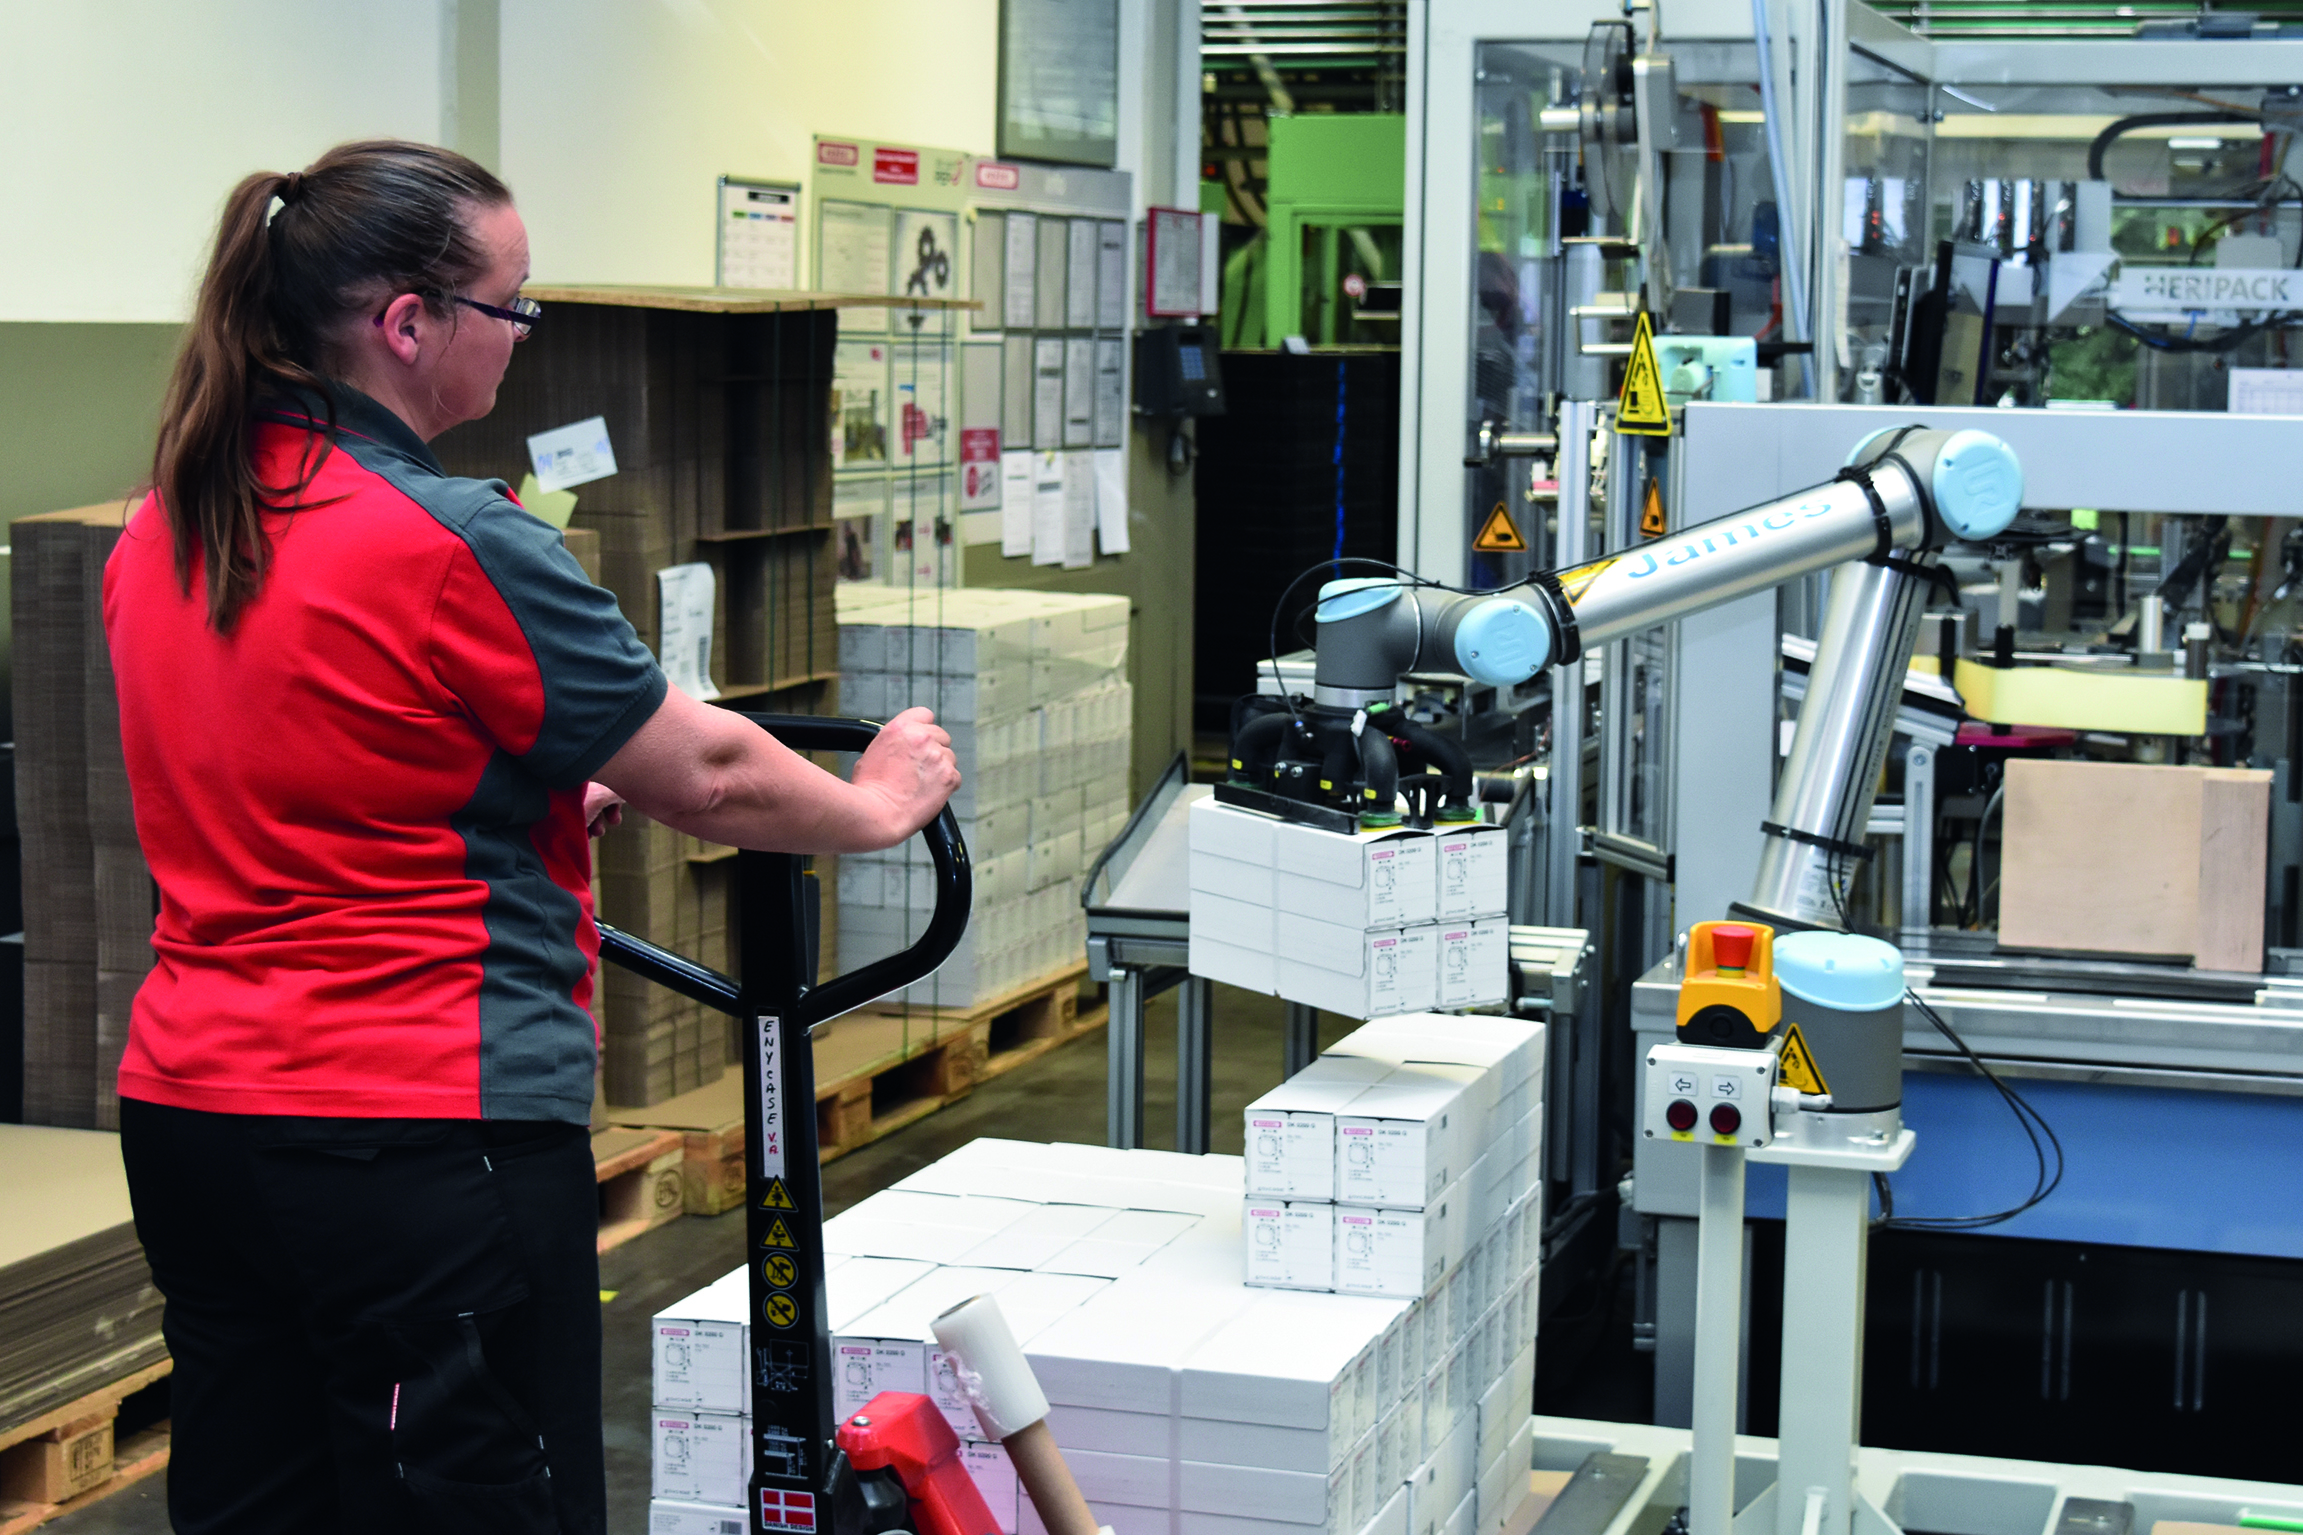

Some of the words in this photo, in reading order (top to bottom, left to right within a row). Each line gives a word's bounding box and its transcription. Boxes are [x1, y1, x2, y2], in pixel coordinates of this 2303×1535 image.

[2144, 274, 2289, 302] HERIPACK
[1627, 500, 1832, 579] James
[763, 1020, 778, 1125] ENYCASE
